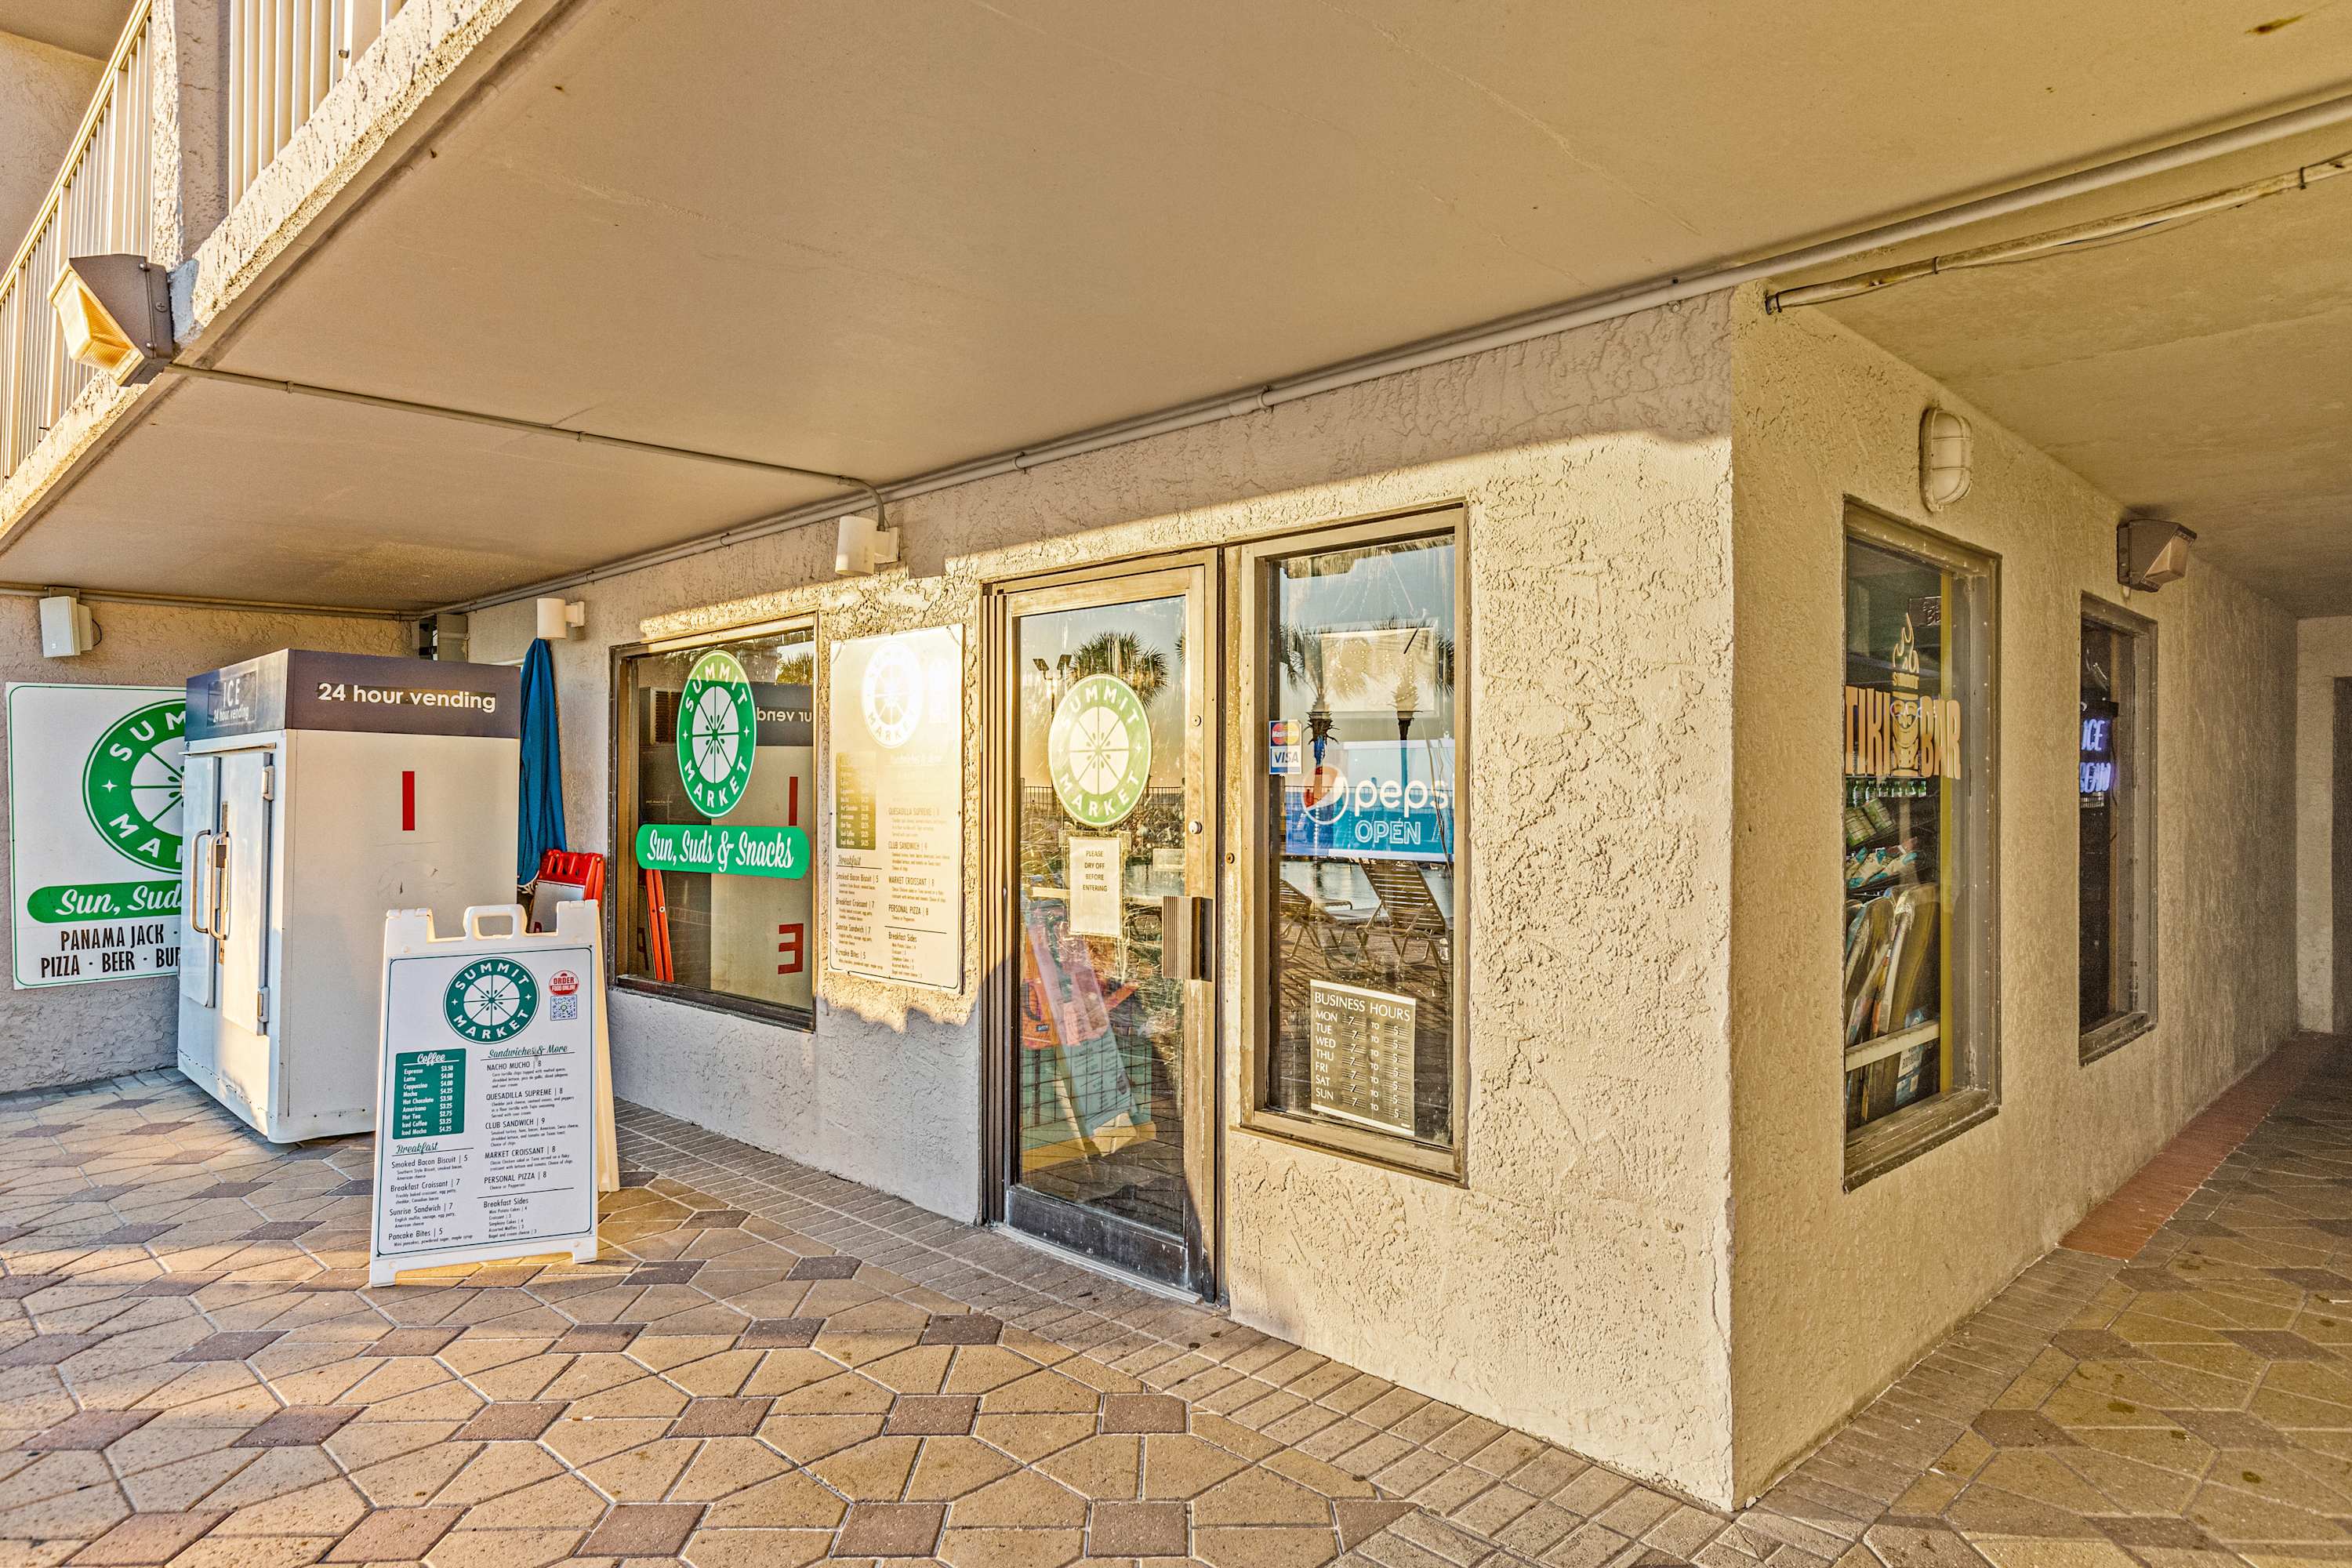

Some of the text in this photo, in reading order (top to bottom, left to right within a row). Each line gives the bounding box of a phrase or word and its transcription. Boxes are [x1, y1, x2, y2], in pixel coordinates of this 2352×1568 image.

[223, 678, 241, 708] ICE
[318, 682, 496, 713] 24 hour vending
[684, 664, 748, 710] SUMMIT
[1059, 684, 1141, 728] SUMMIT
[1846, 685, 1960, 779] TIKI BAR
[2082, 718, 2105, 751] ICE
[1275, 752, 1299, 764] VISA
[684, 755, 747, 809] MARKET
[1058, 769, 1141, 817] MARKET
[1355, 820, 1421, 844] OPEN
[647, 829, 794, 873] Sun, Suds & Snacks
[55, 883, 181, 916] Sun, Sud
[60, 924, 164, 951] PANAMA JACK
[41, 955, 80, 978] PIZZA
[102, 951, 136, 972] BEER
[455, 962, 529, 991] SUMMIT
[553, 976, 575, 985] ORDER
[1314, 992, 1410, 1022] BUSINESS HOURS
[452, 1009, 530, 1040] MARKET
[1316, 1010, 1338, 1022] MON
[1348, 1016, 1355, 1025] 7
[1393, 1026, 1399, 1036] 5
[1316, 1022, 1332, 1034] TUE
[1352, 1030, 1358, 1040] 7
[1392, 1040, 1399, 1050] 5
[417, 1052, 446, 1066] Coffee
[488, 1047, 535, 1058] Sandwiches
[546, 1044, 568, 1054] More
[1316, 1036, 1336, 1048] WED
[1351, 1044, 1357, 1053] 7
[1392, 1054, 1399, 1062] 5
[1316, 1049, 1334, 1061] THU
[1350, 1057, 1356, 1065] 7
[1393, 1068, 1399, 1077] 5
[1316, 1062, 1328, 1073] FRI
[1351, 1070, 1357, 1079] 7
[1393, 1080, 1399, 1090] 5
[486, 1091, 522, 1101] QUESADILLA
[524, 1088, 552, 1097] SUPREME
[1316, 1075, 1330, 1087] SAT
[1350, 1083, 1356, 1092] 7
[1392, 1094, 1399, 1104] 5
[1316, 1087, 1334, 1101] SUN
[1352, 1097, 1358, 1106] 7
[1394, 1108, 1399, 1118] 5
[503, 1119, 534, 1127] SANDWICH
[395, 1142, 438, 1155] Breakfast
[511, 1147, 544, 1156] CROISSANT
[391, 1160, 416, 1168] Smoked
[390, 1183, 419, 1192] Breakfast
[484, 1175, 515, 1184] PERSONAL
[414, 1203, 441, 1214] Sandwich
[484, 1199, 511, 1208] Breakfast
[388, 1232, 413, 1240] Pancake
